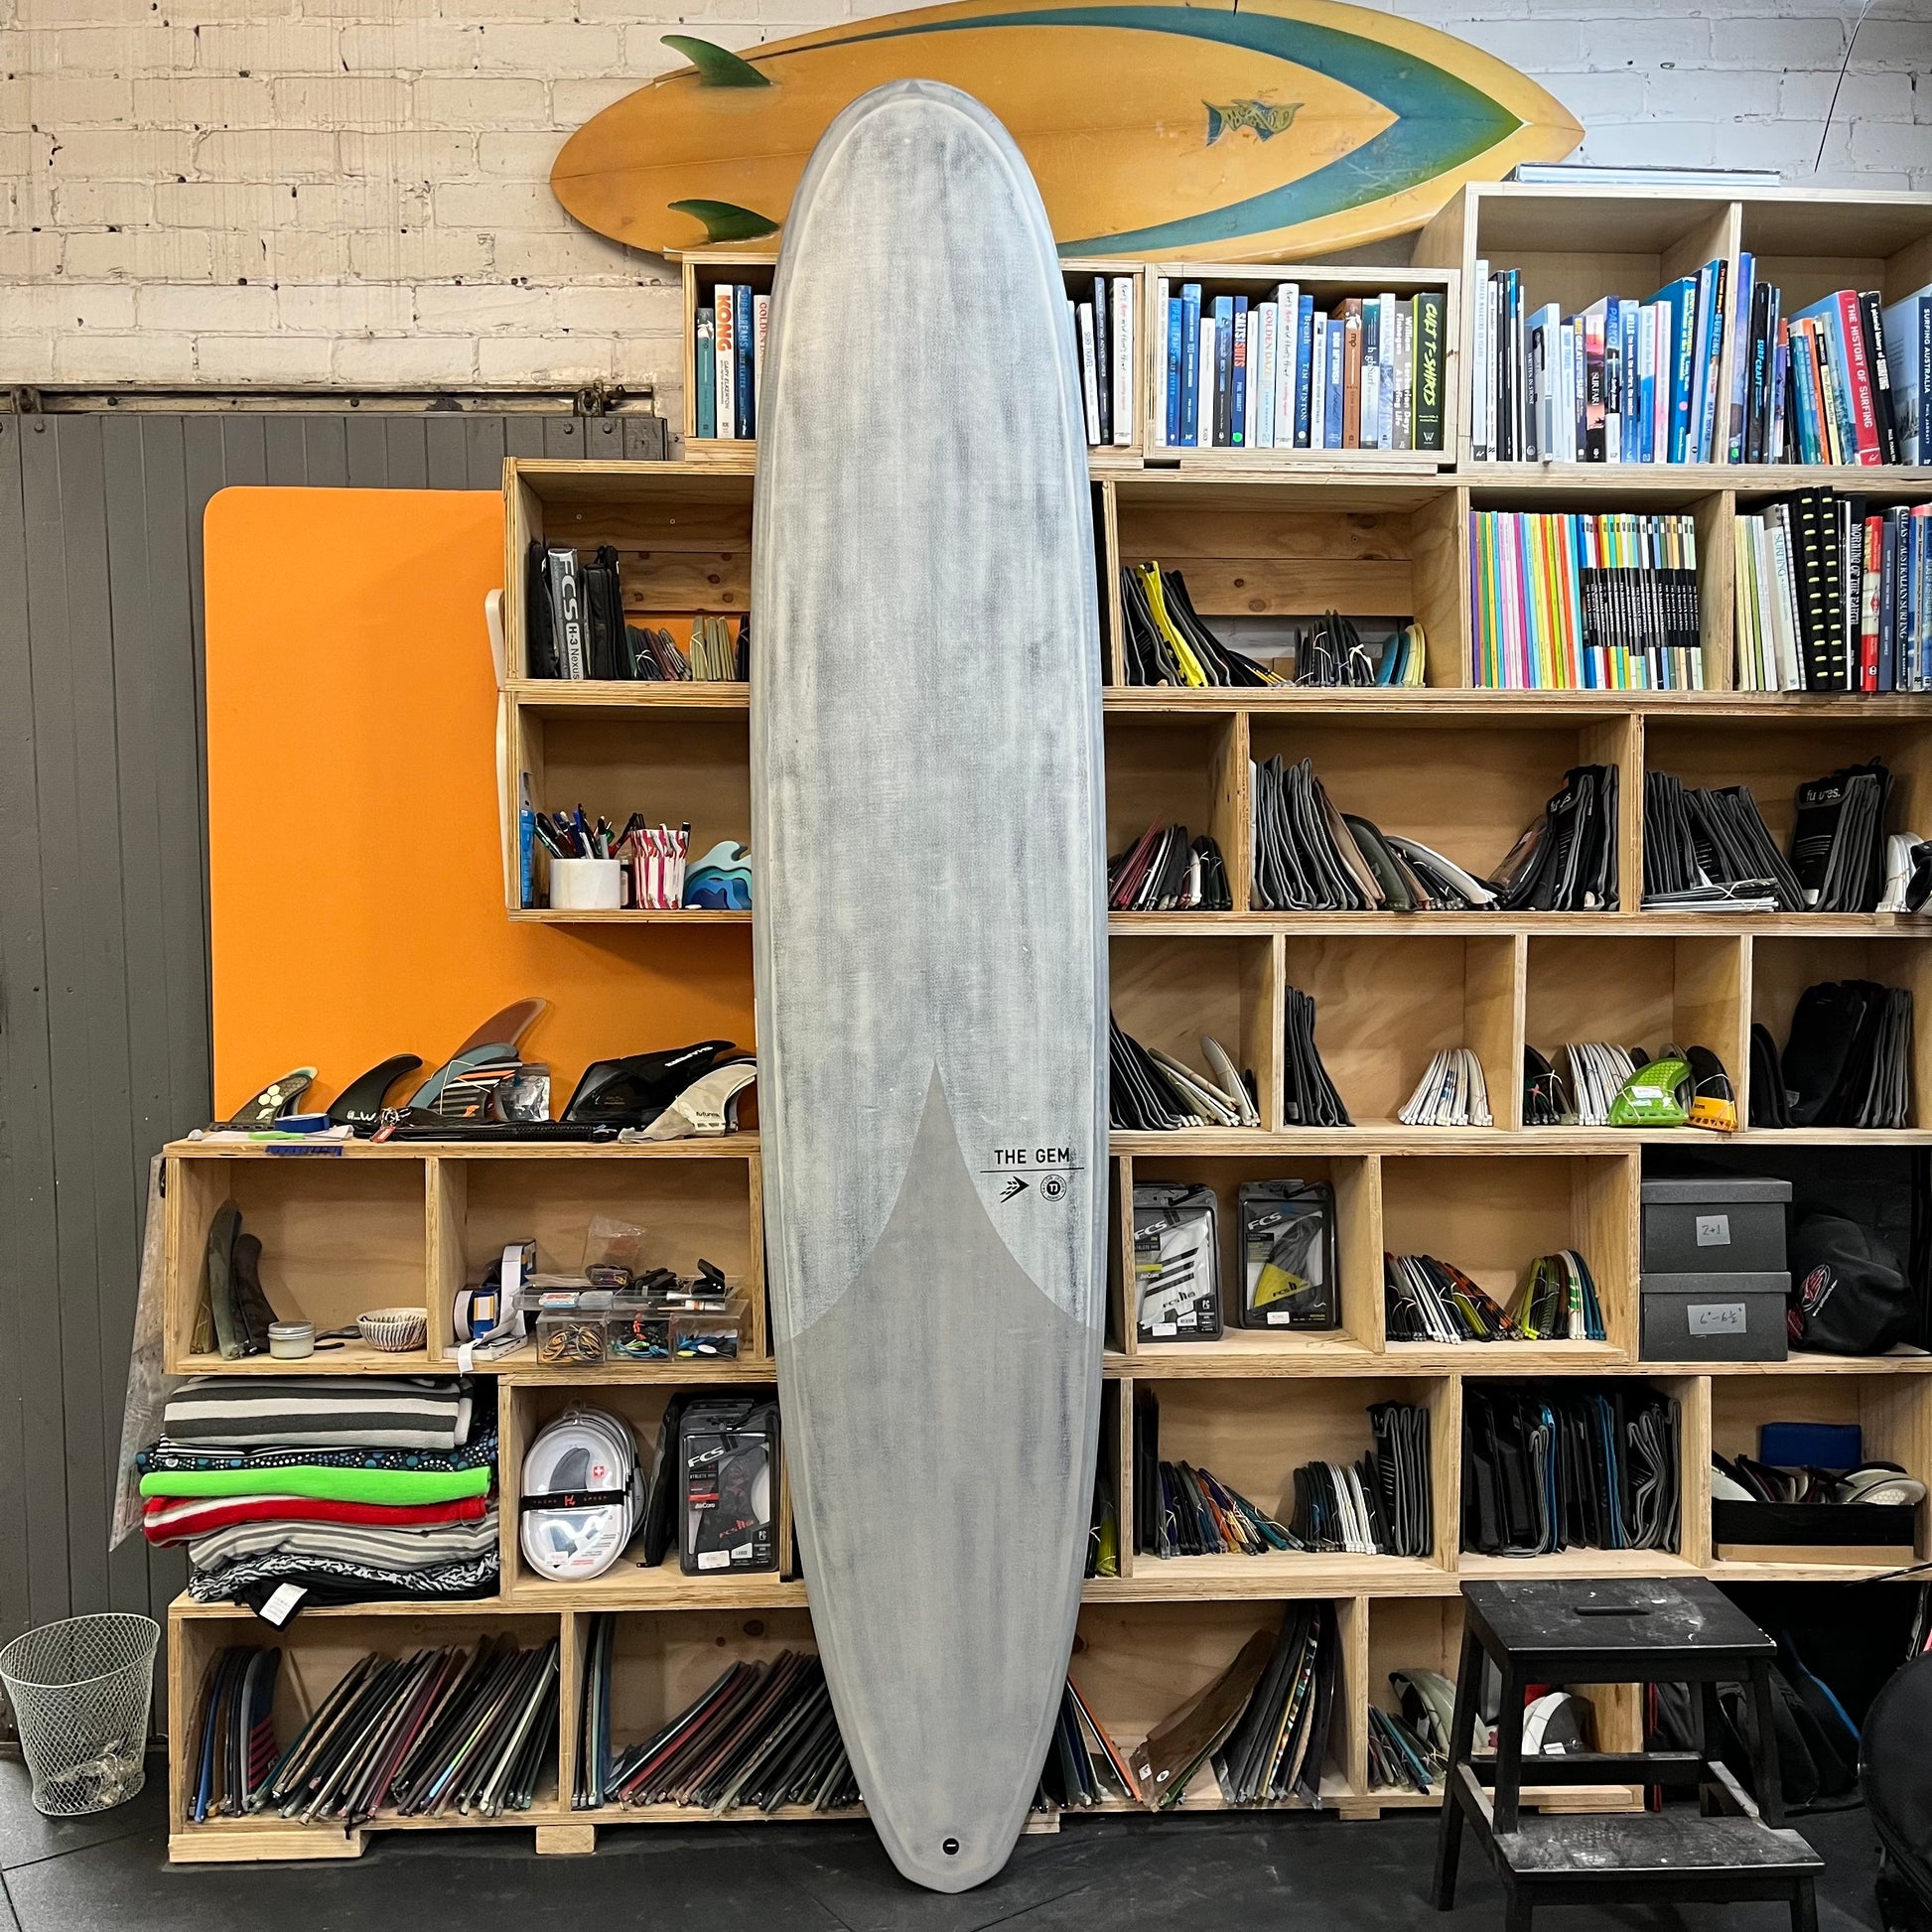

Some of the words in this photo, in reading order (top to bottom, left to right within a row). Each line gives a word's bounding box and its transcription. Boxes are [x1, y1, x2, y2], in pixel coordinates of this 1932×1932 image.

[717, 295, 733, 351] KONG
[740, 314, 749, 347] DREAMS
[1235, 313, 1246, 339] SALTS
[1395, 313, 1404, 355] Finnegan
[1423, 303, 1438, 340] CULT
[1609, 307, 1618, 344] PARKO
[1712, 314, 1723, 355] SURFING
[1870, 309, 1881, 331] pictorial
[1349, 333, 1358, 347] mp
[1575, 335, 1583, 360] GREAT
[1851, 326, 1862, 366] HISTORY
[1873, 331, 1882, 350] history
[1234, 344, 1245, 367] SUITS
[1365, 346, 1377, 386] hghSurf
[1755, 339, 1765, 386] SURFCRAFT
[1423, 341, 1438, 406] T-SHIRTS
[1857, 370, 1865, 382] OF
[1876, 359, 1890, 390] SURFING
[1300, 383, 1309, 420] WINTON
[1591, 372, 1599, 406] SURFARI
[1860, 386, 1873, 428] SURFING
[1403, 411, 1411, 434] Days
[1901, 511, 1909, 537] ATLAS
[1774, 533, 1787, 577] SURFING
[1851, 523, 1862, 563] MORNING
[1851, 565, 1861, 576] OF
[559, 554, 578, 621] FCS
[1850, 578, 1860, 594] THE
[1850, 596, 1859, 625] EARTH
[569, 626, 578, 645] H-3
[570, 648, 580, 679] Nexus
[1806, 788, 1841, 802] fuues.
[994, 1149, 1027, 1164] THE
[1036, 1147, 1070, 1163] GEM
[1135, 1220, 1167, 1241] FCS
[1248, 1212, 1282, 1231] FCS
[1701, 1224, 1721, 1236] 2+1
[688, 1446, 724, 1468] FCS
